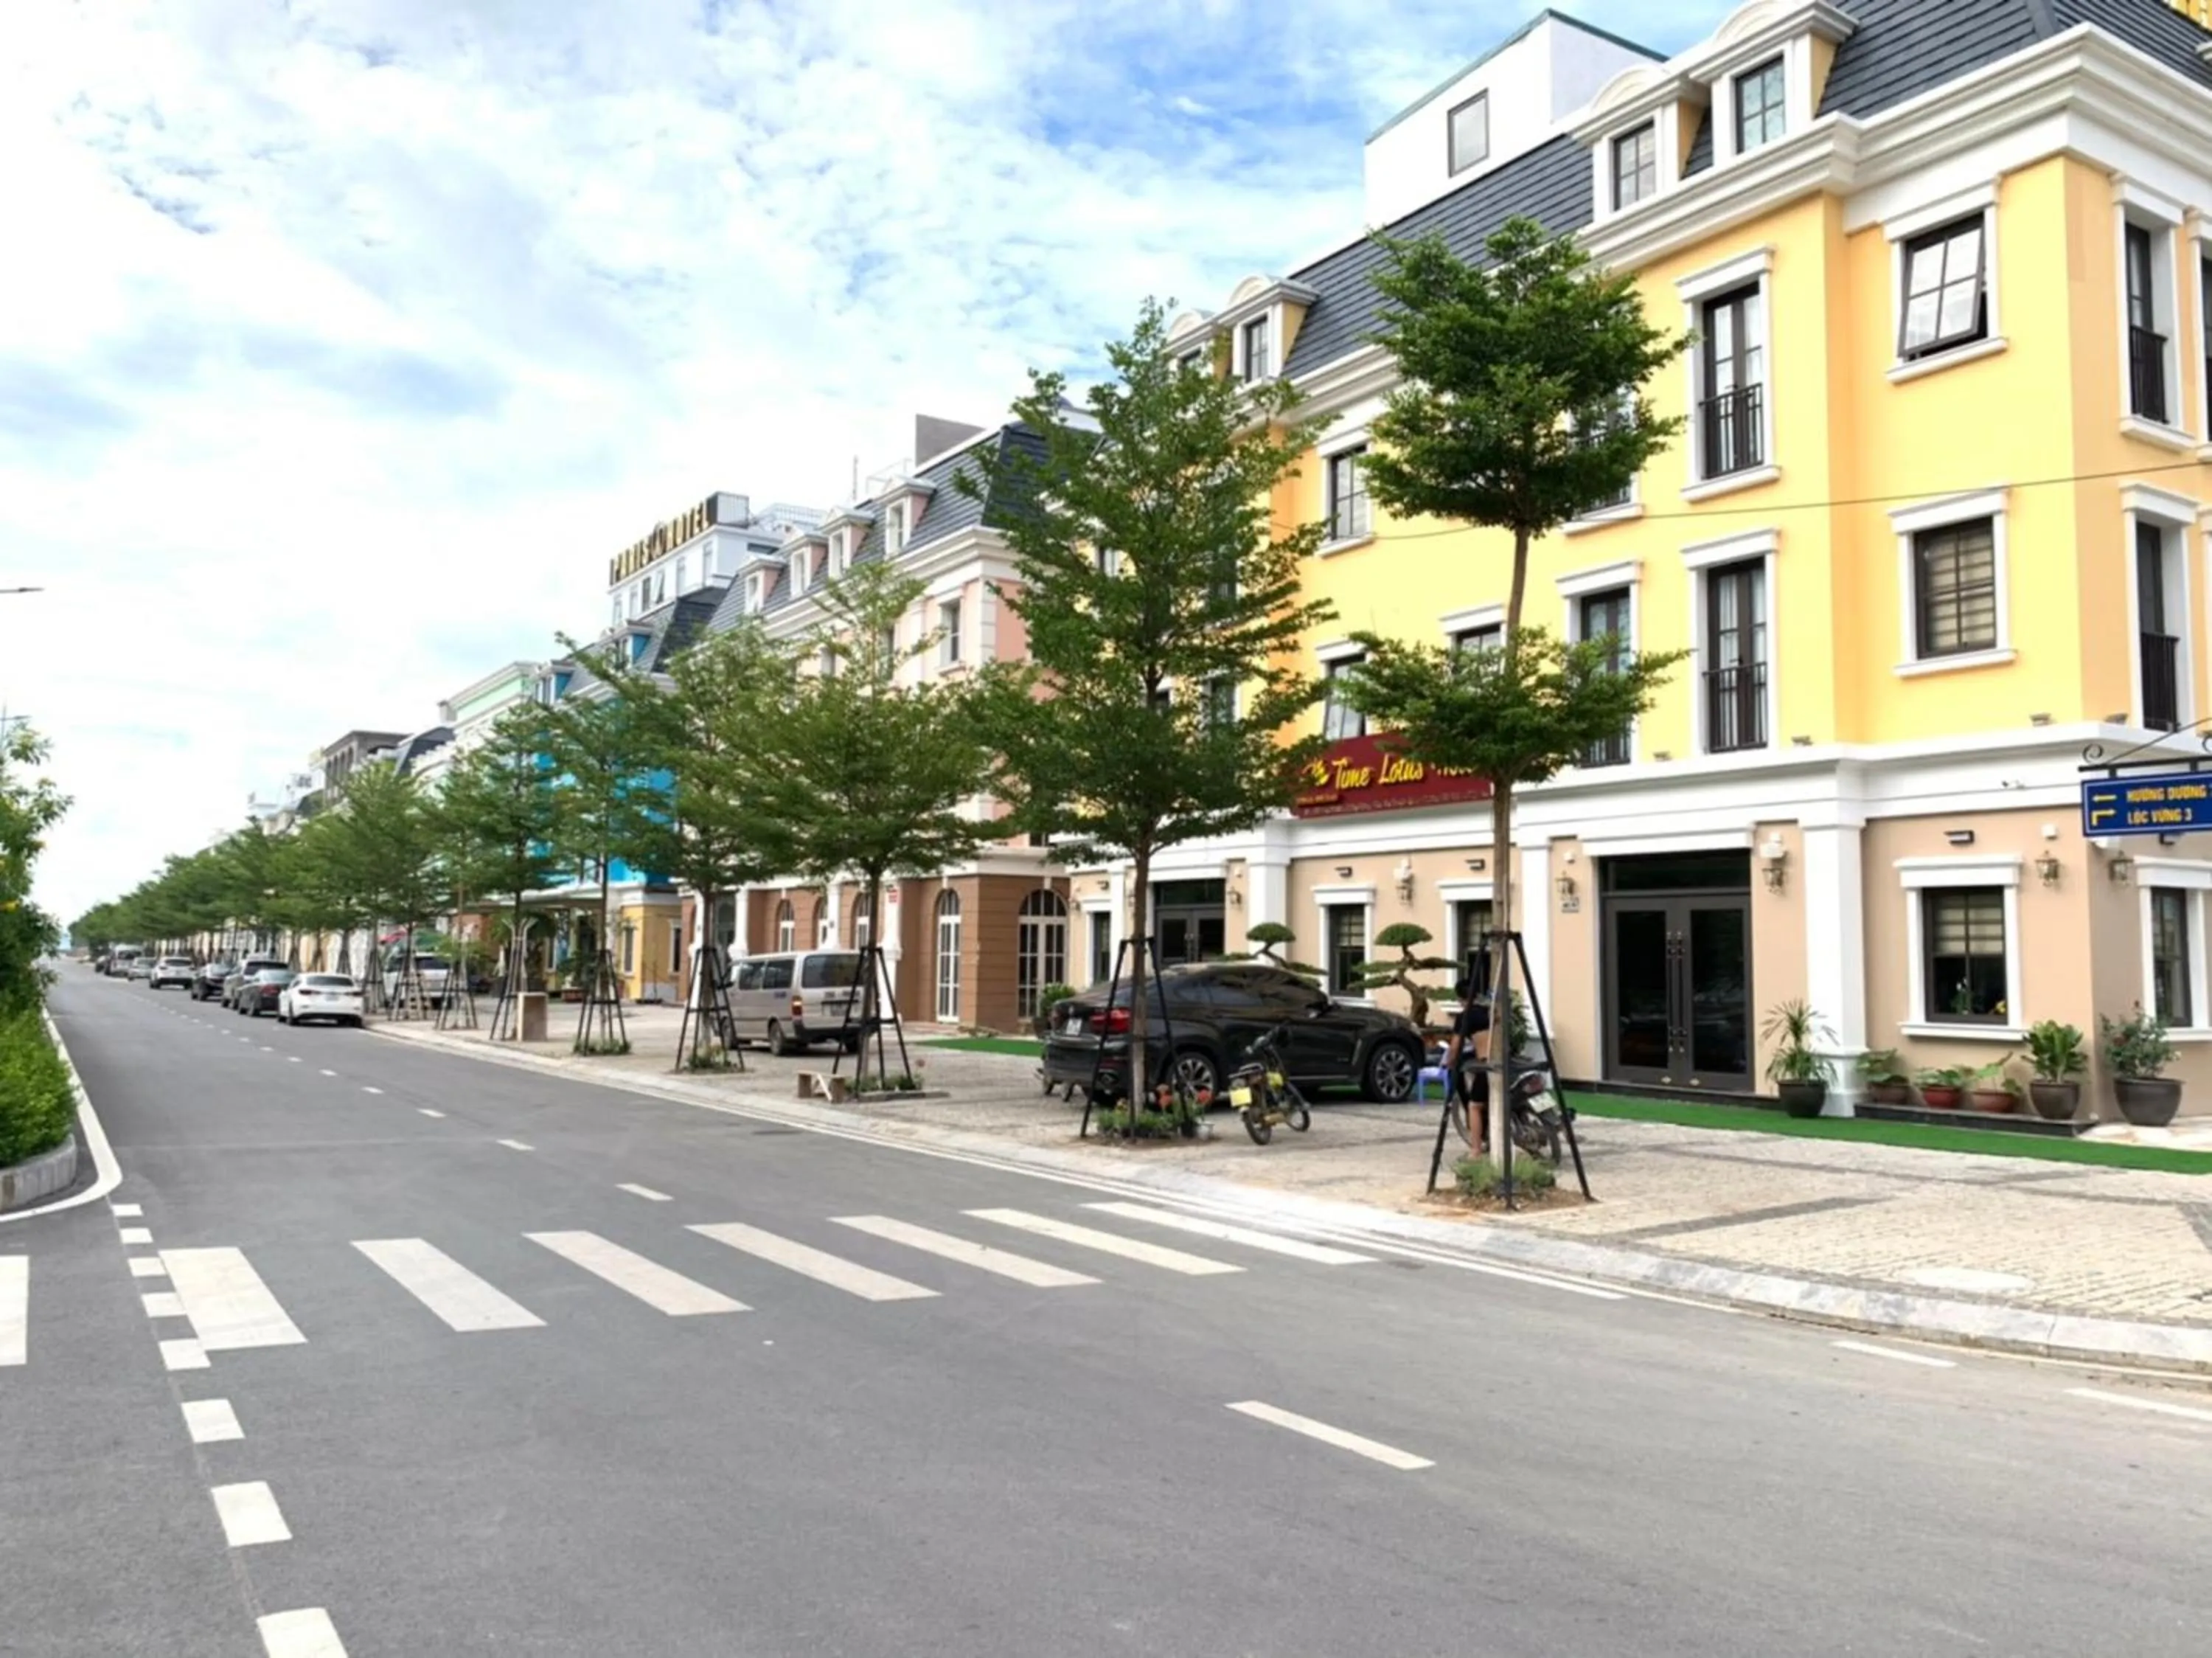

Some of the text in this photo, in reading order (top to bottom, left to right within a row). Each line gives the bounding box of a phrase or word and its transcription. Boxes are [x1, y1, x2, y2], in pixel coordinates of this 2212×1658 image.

[1332, 756, 1371, 789] Time
[1377, 753, 1423, 785] Lotus
[2185, 807, 2192, 822] 3
